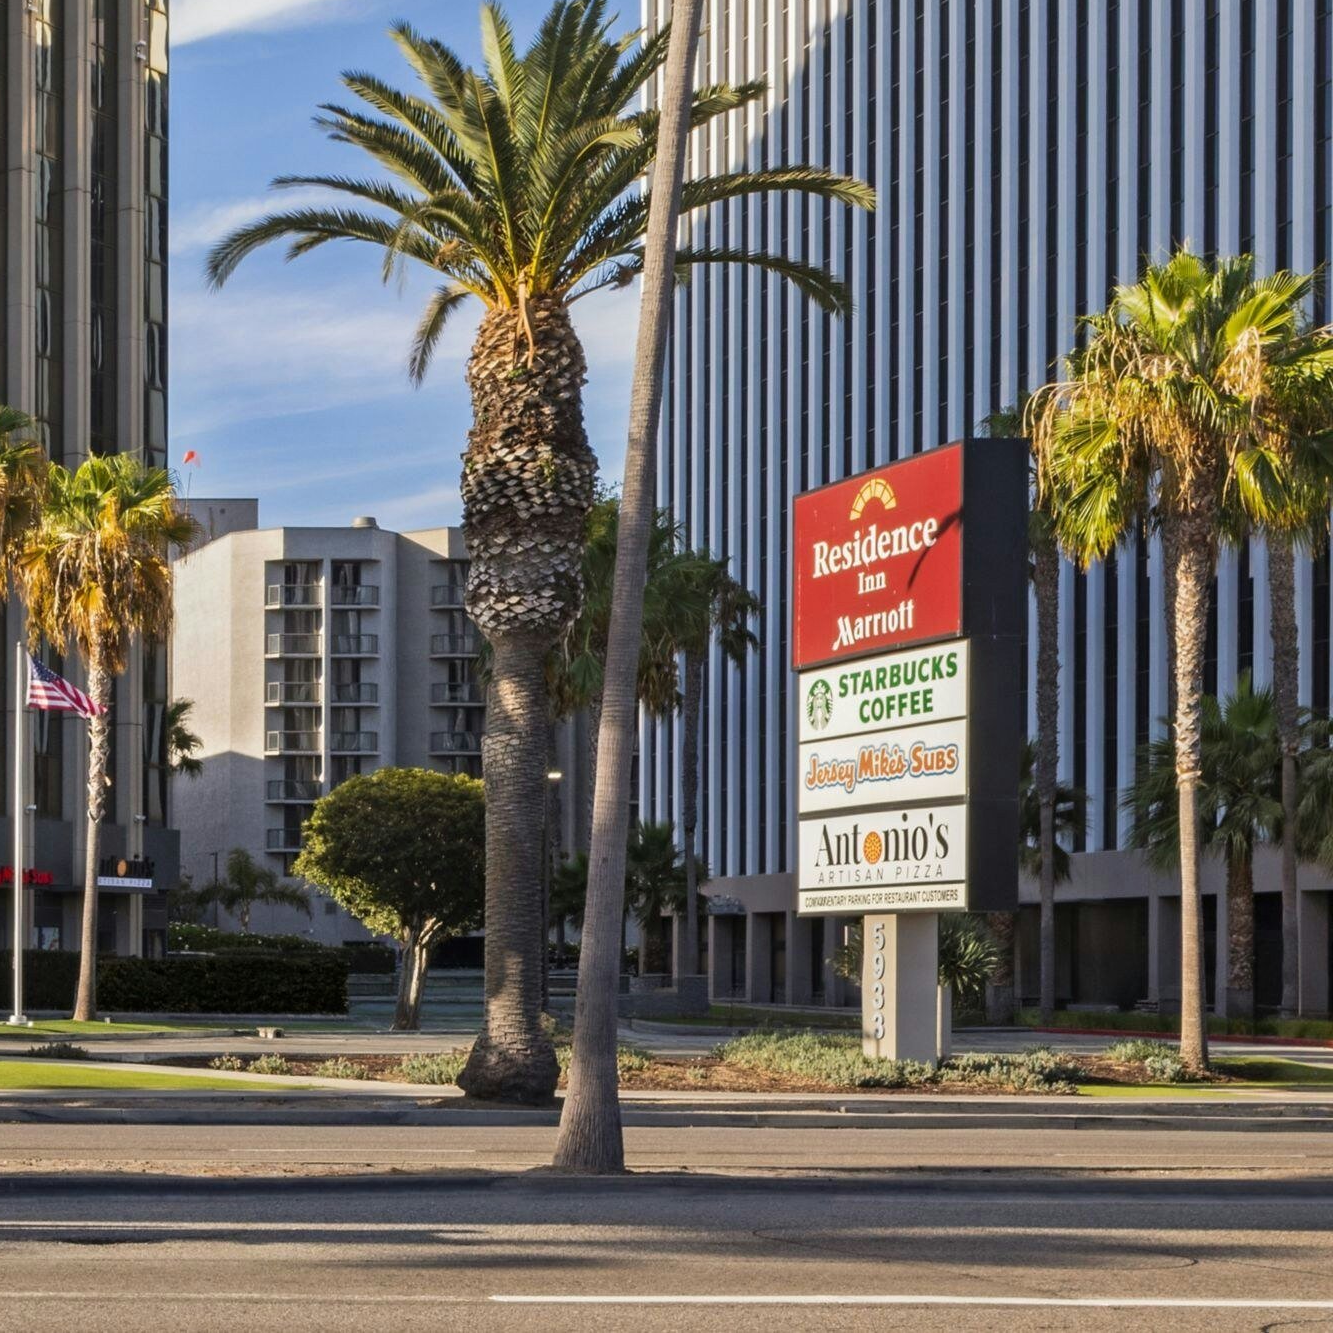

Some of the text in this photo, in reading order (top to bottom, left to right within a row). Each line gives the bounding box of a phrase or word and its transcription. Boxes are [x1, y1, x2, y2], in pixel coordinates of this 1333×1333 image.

[813, 517, 938, 578] Residence
[858, 571, 887, 594] Inn
[832, 599, 914, 651] Marriott
[838, 652, 958, 698] STARBUCKS
[859, 688, 934, 723] COFFEE
[806, 754, 855, 792] Jersey
[857, 743, 908, 782] Mike's
[818, 864, 944, 884] ARTISAN PIZZA
[848, 892, 871, 905] PARKING
[872, 891, 883, 904] FOR
[884, 890, 922, 904] RESTAURANT
[922, 888, 959, 902] CUSTOMERS
[874, 922, 885, 1040] 5933
